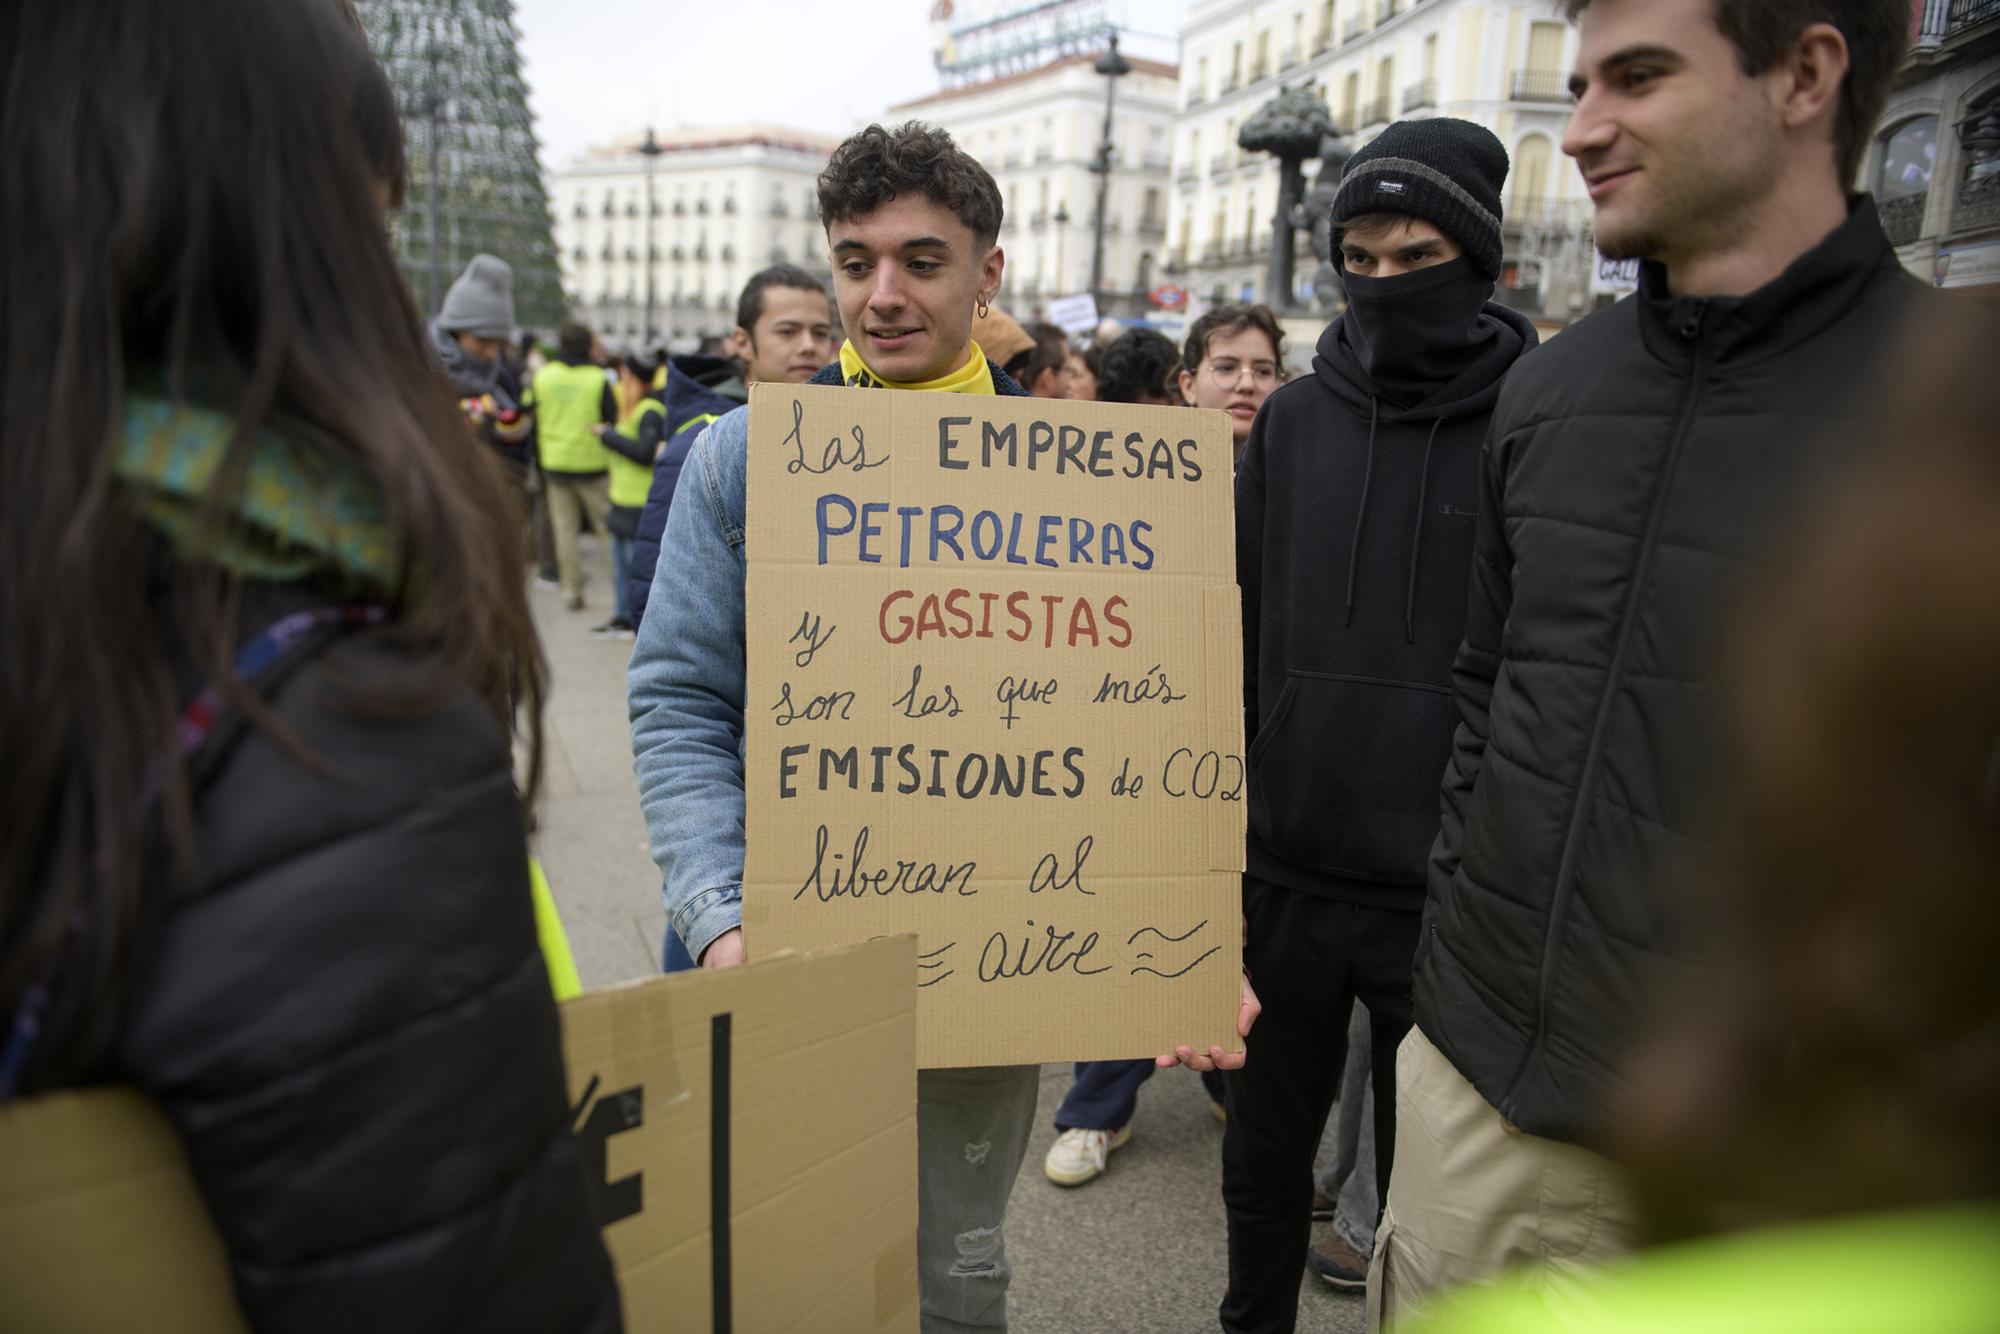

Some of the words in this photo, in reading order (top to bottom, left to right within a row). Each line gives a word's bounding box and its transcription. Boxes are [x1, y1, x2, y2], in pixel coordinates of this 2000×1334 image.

[783, 400, 890, 474] Las
[938, 416, 1203, 483] EMPRESAS
[815, 493, 1156, 571] PETROLERAS
[788, 611, 837, 668] y
[879, 588, 1133, 649] GASISTAS
[771, 682, 856, 727] son
[997, 675, 1058, 730] que
[1092, 664, 1187, 704] más
[779, 743, 1085, 799] EMISIONES
[1110, 757, 1144, 799] de
[1162, 747, 1244, 801] CO2
[794, 824, 979, 902] liberan
[1029, 834, 1096, 895] al
[977, 919, 1113, 983] aire
